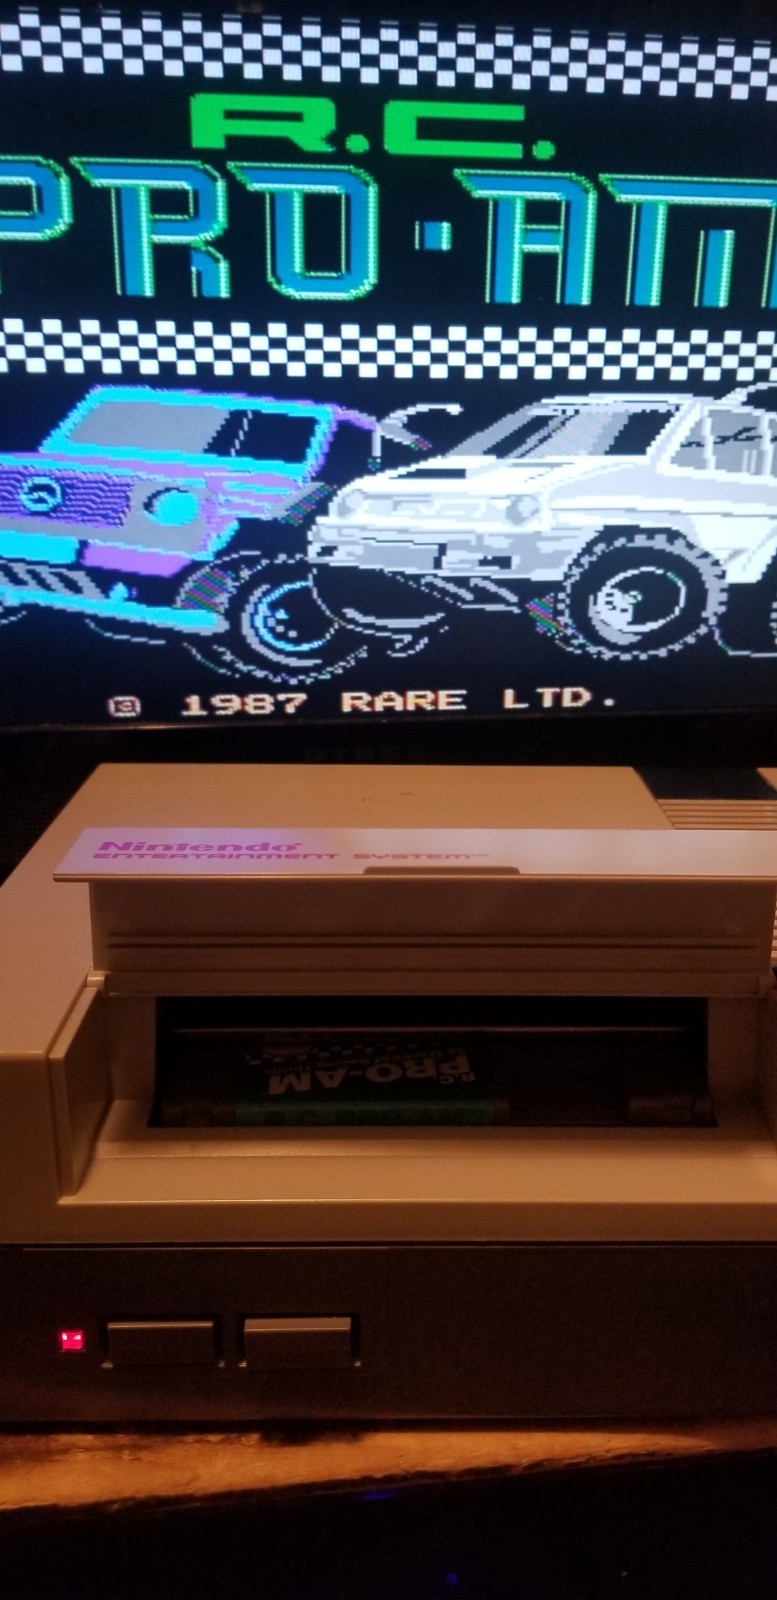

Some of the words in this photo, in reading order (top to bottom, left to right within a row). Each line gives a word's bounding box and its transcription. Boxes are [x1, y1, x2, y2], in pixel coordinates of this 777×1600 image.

[190, 93, 556, 159] R.C.
[181, 692, 308, 717] 1987
[341, 689, 468, 713] RARE
[504, 686, 615, 709] LTD.
[268, 1053, 472, 1096] PRO-AM
